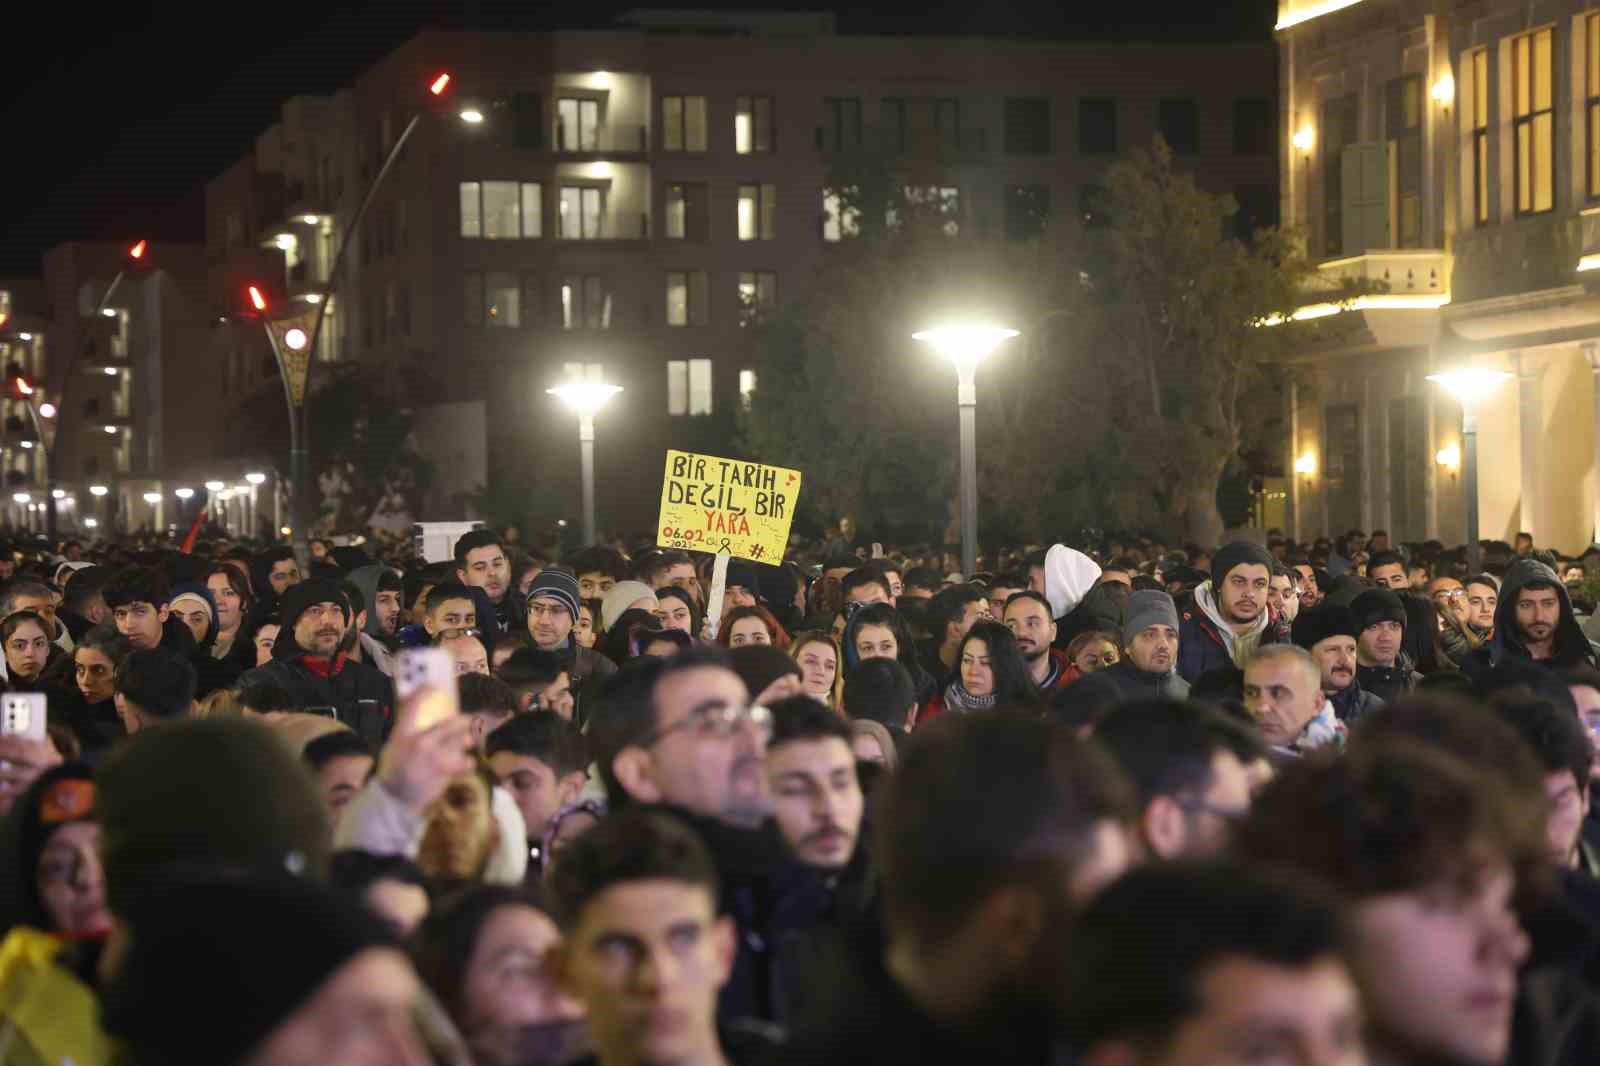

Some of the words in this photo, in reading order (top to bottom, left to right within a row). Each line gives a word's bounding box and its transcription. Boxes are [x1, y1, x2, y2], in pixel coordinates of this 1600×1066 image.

[672, 455, 707, 481] BİR
[718, 462, 777, 490] TARİH
[668, 480, 748, 516] DEĞİL,
[755, 491, 786, 519] BİR
[663, 527, 705, 543] 06.02
[705, 510, 751, 536] YARA
